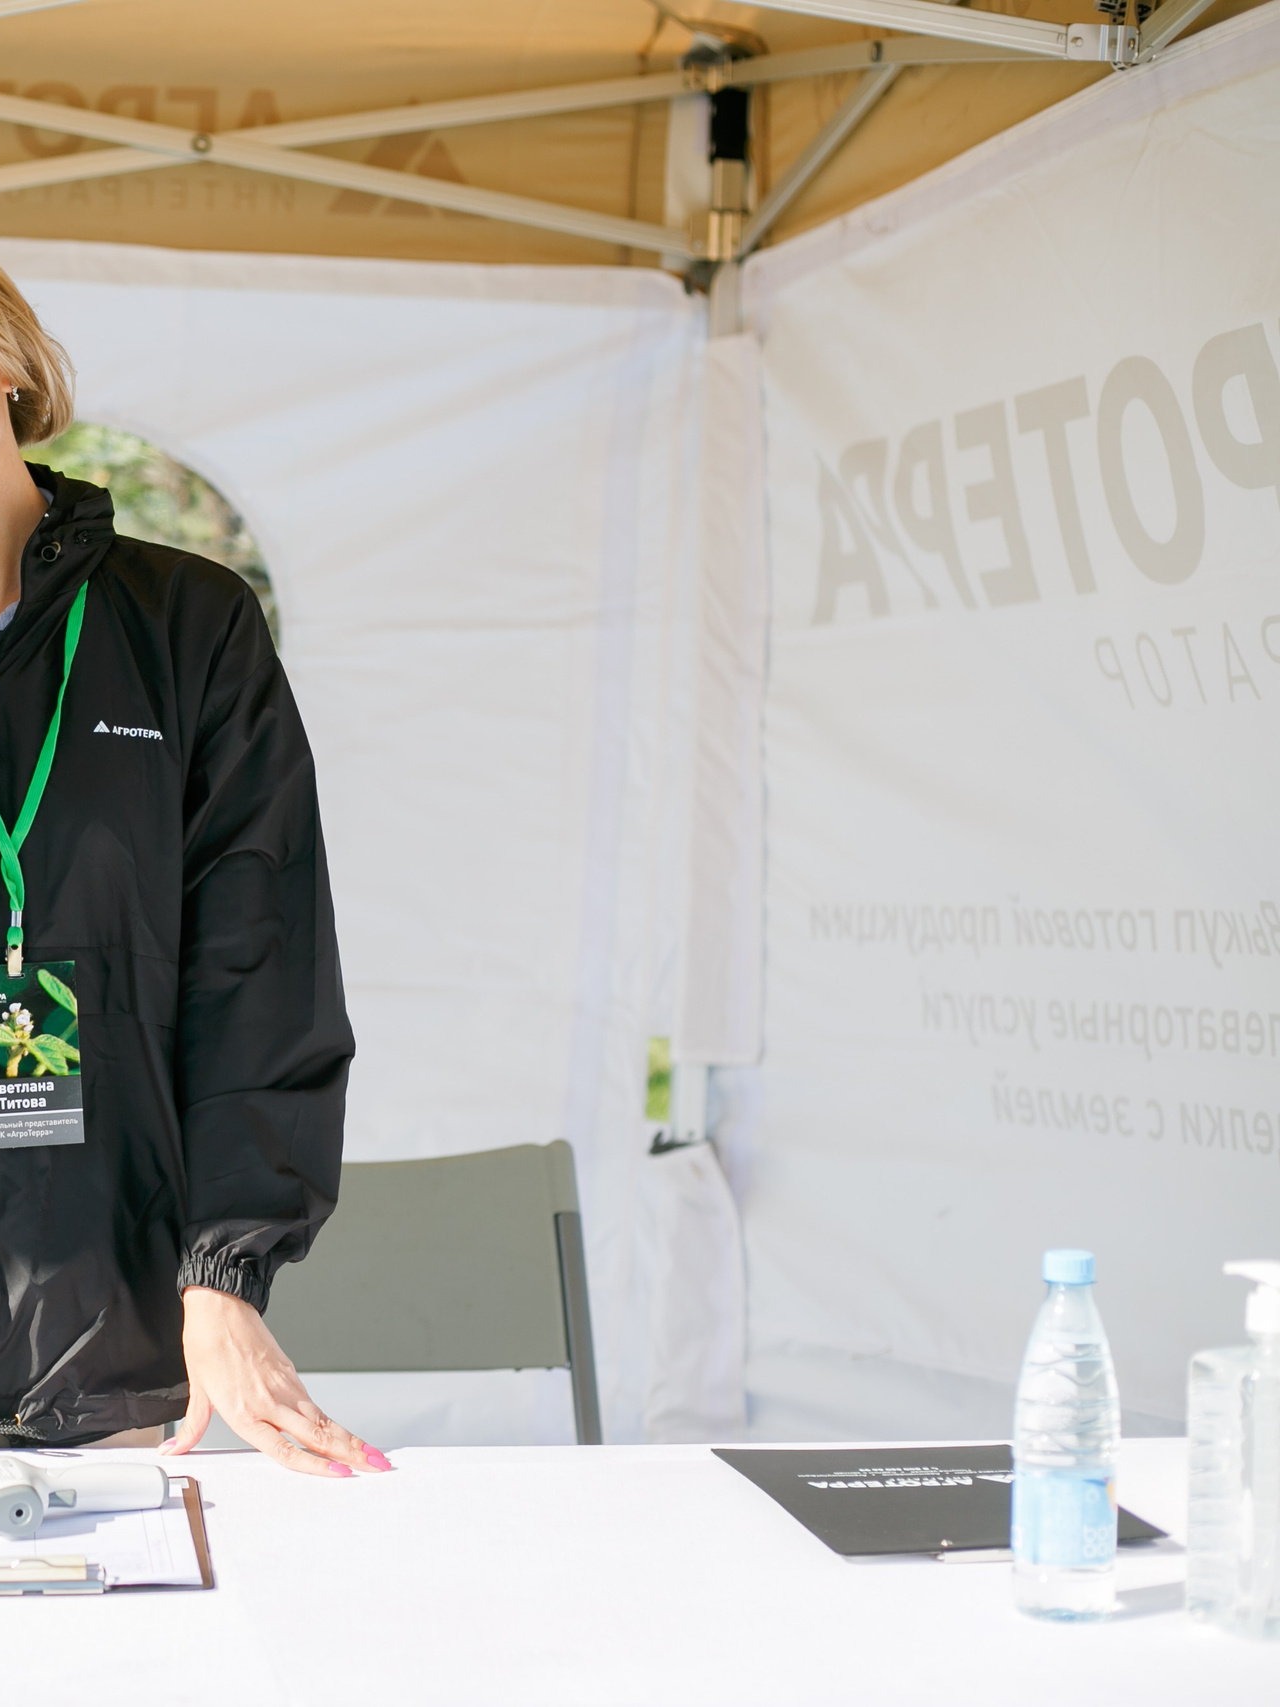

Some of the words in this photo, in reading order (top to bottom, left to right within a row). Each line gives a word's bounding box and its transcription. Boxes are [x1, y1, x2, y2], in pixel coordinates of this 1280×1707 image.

[24, 1118, 79, 1129] представитель
[7, 1129, 54, 1139] «АгроТерра»
[807, 1476, 974, 1490] АГРОТЕРРА
